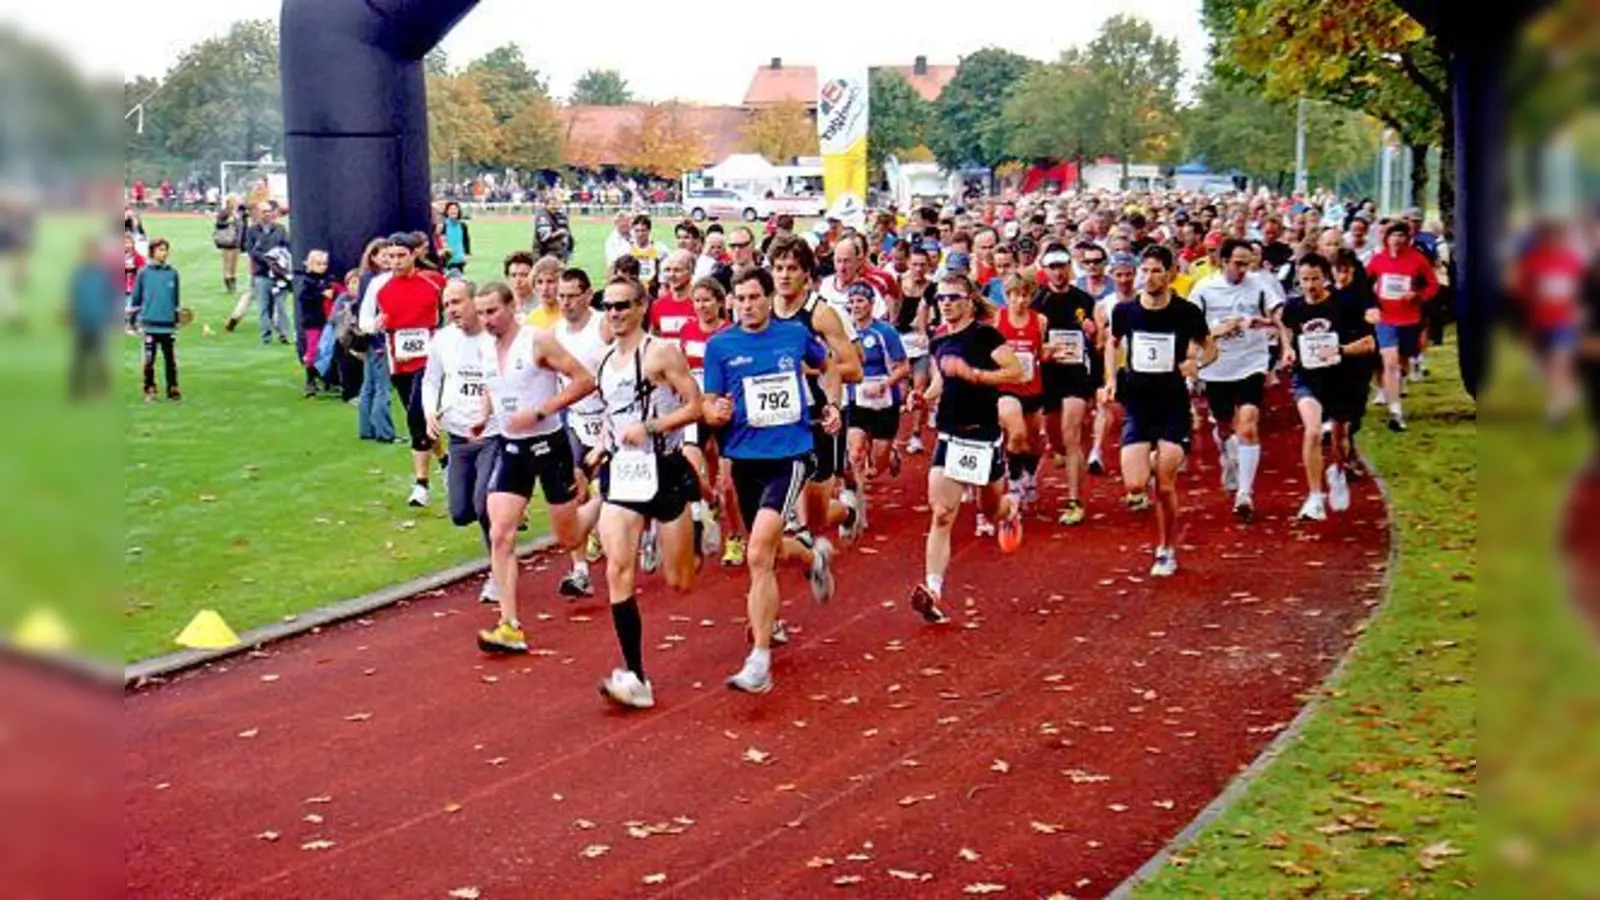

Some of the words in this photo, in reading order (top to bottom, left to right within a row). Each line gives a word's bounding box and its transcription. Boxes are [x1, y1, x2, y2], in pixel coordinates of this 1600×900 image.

[1147, 347, 1157, 361] 3
[757, 390, 790, 410] 792
[959, 455, 977, 470] 46
